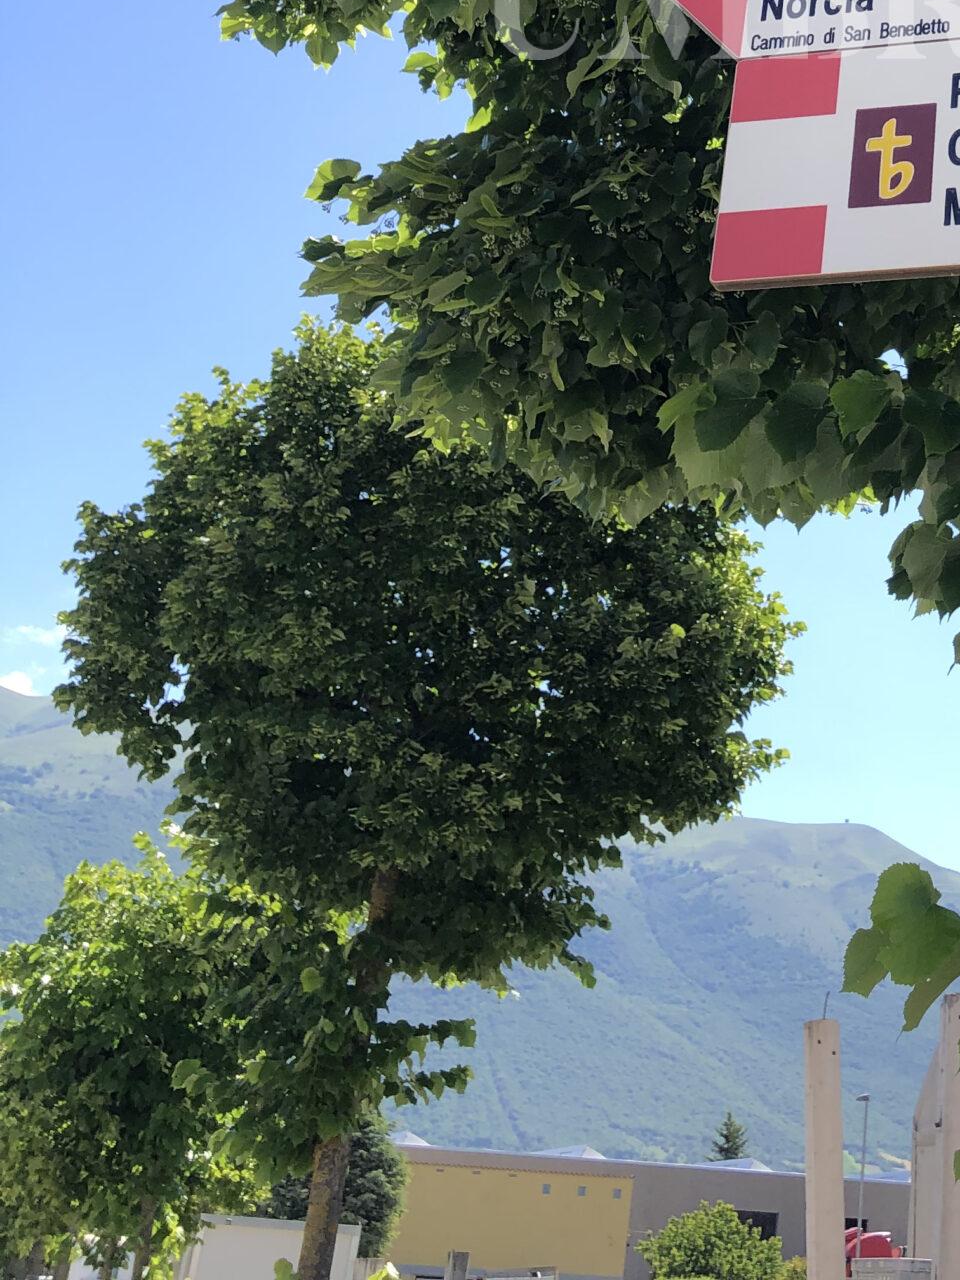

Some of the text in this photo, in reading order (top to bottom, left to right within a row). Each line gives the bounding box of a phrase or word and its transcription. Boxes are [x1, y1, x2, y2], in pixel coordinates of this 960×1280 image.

[750, 18, 951, 51] Cammino di San Benedetto
